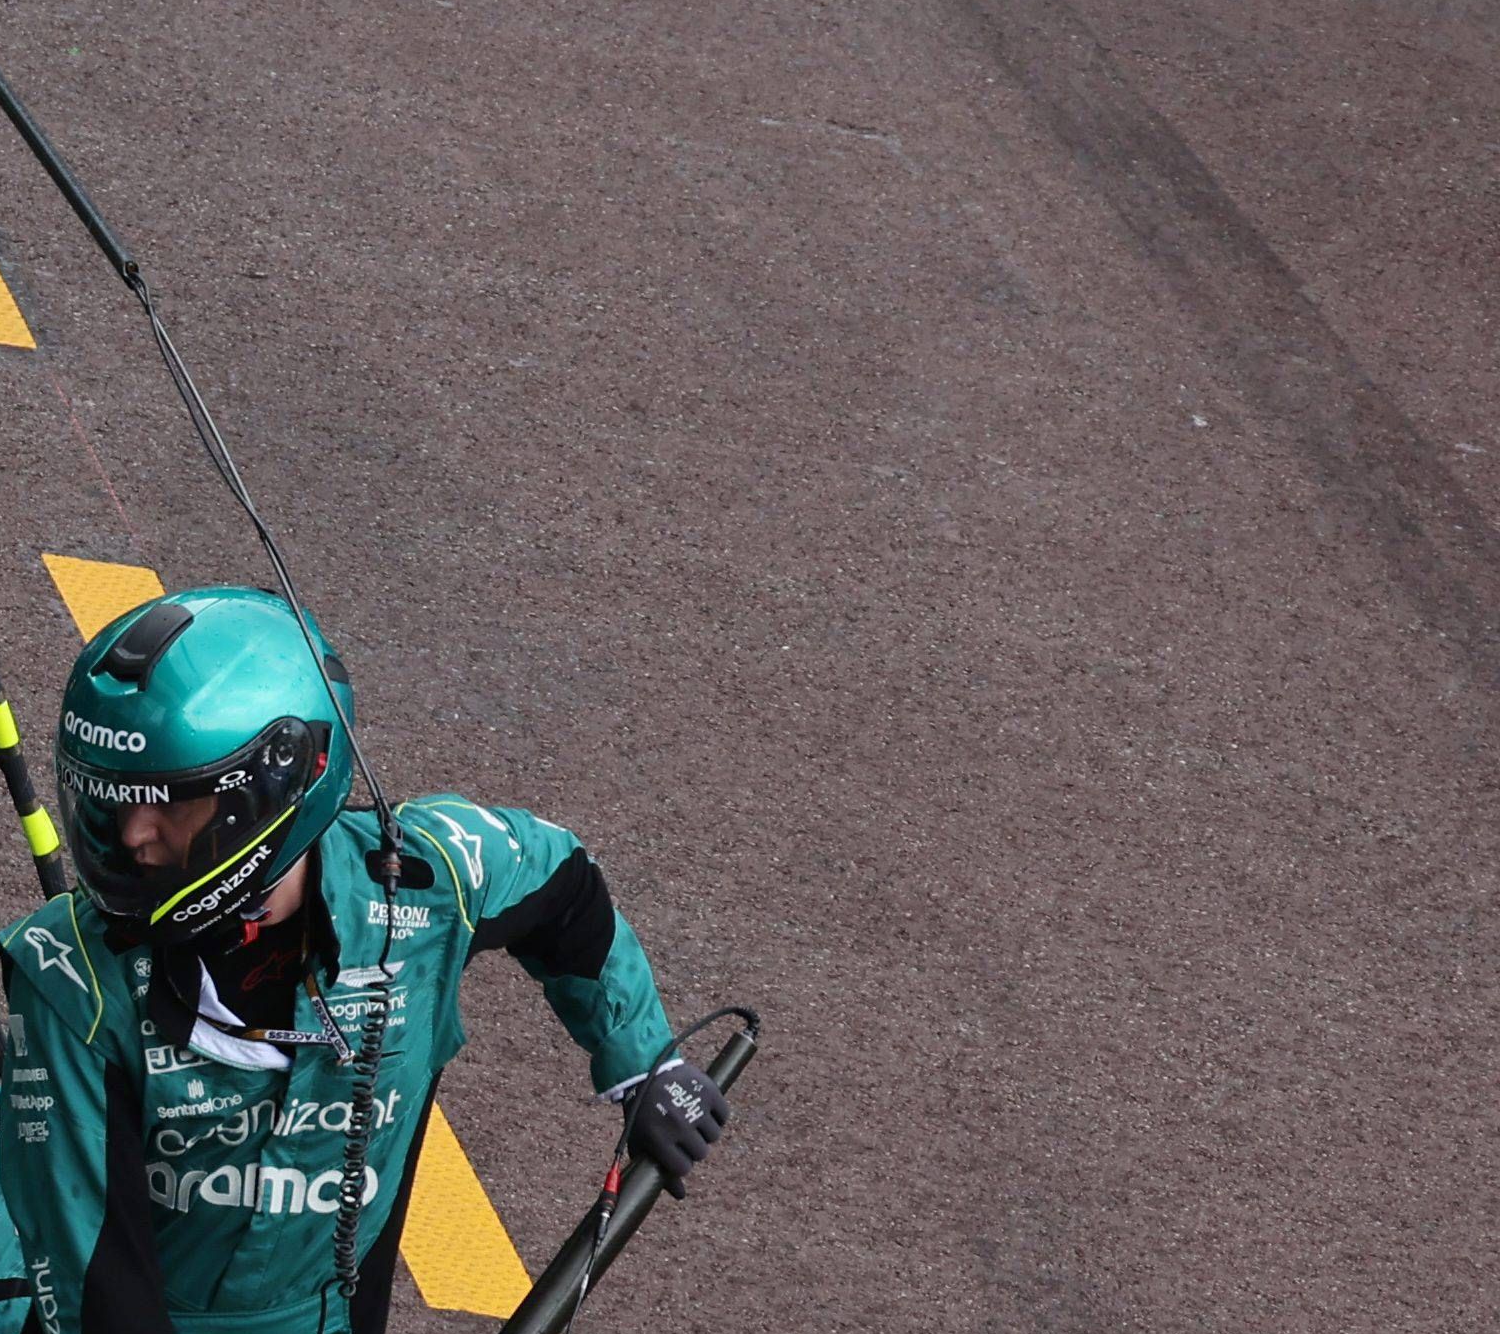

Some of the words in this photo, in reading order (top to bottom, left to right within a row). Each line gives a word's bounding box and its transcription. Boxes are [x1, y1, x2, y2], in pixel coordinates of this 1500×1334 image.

[63, 709, 147, 754] aramco
[87, 780, 170, 805] MARTIN
[172, 843, 272, 923] cognizant
[367, 900, 431, 922] PERONI
[156, 1094, 243, 1120] SentinelOne
[145, 1161, 379, 1216] aramco
